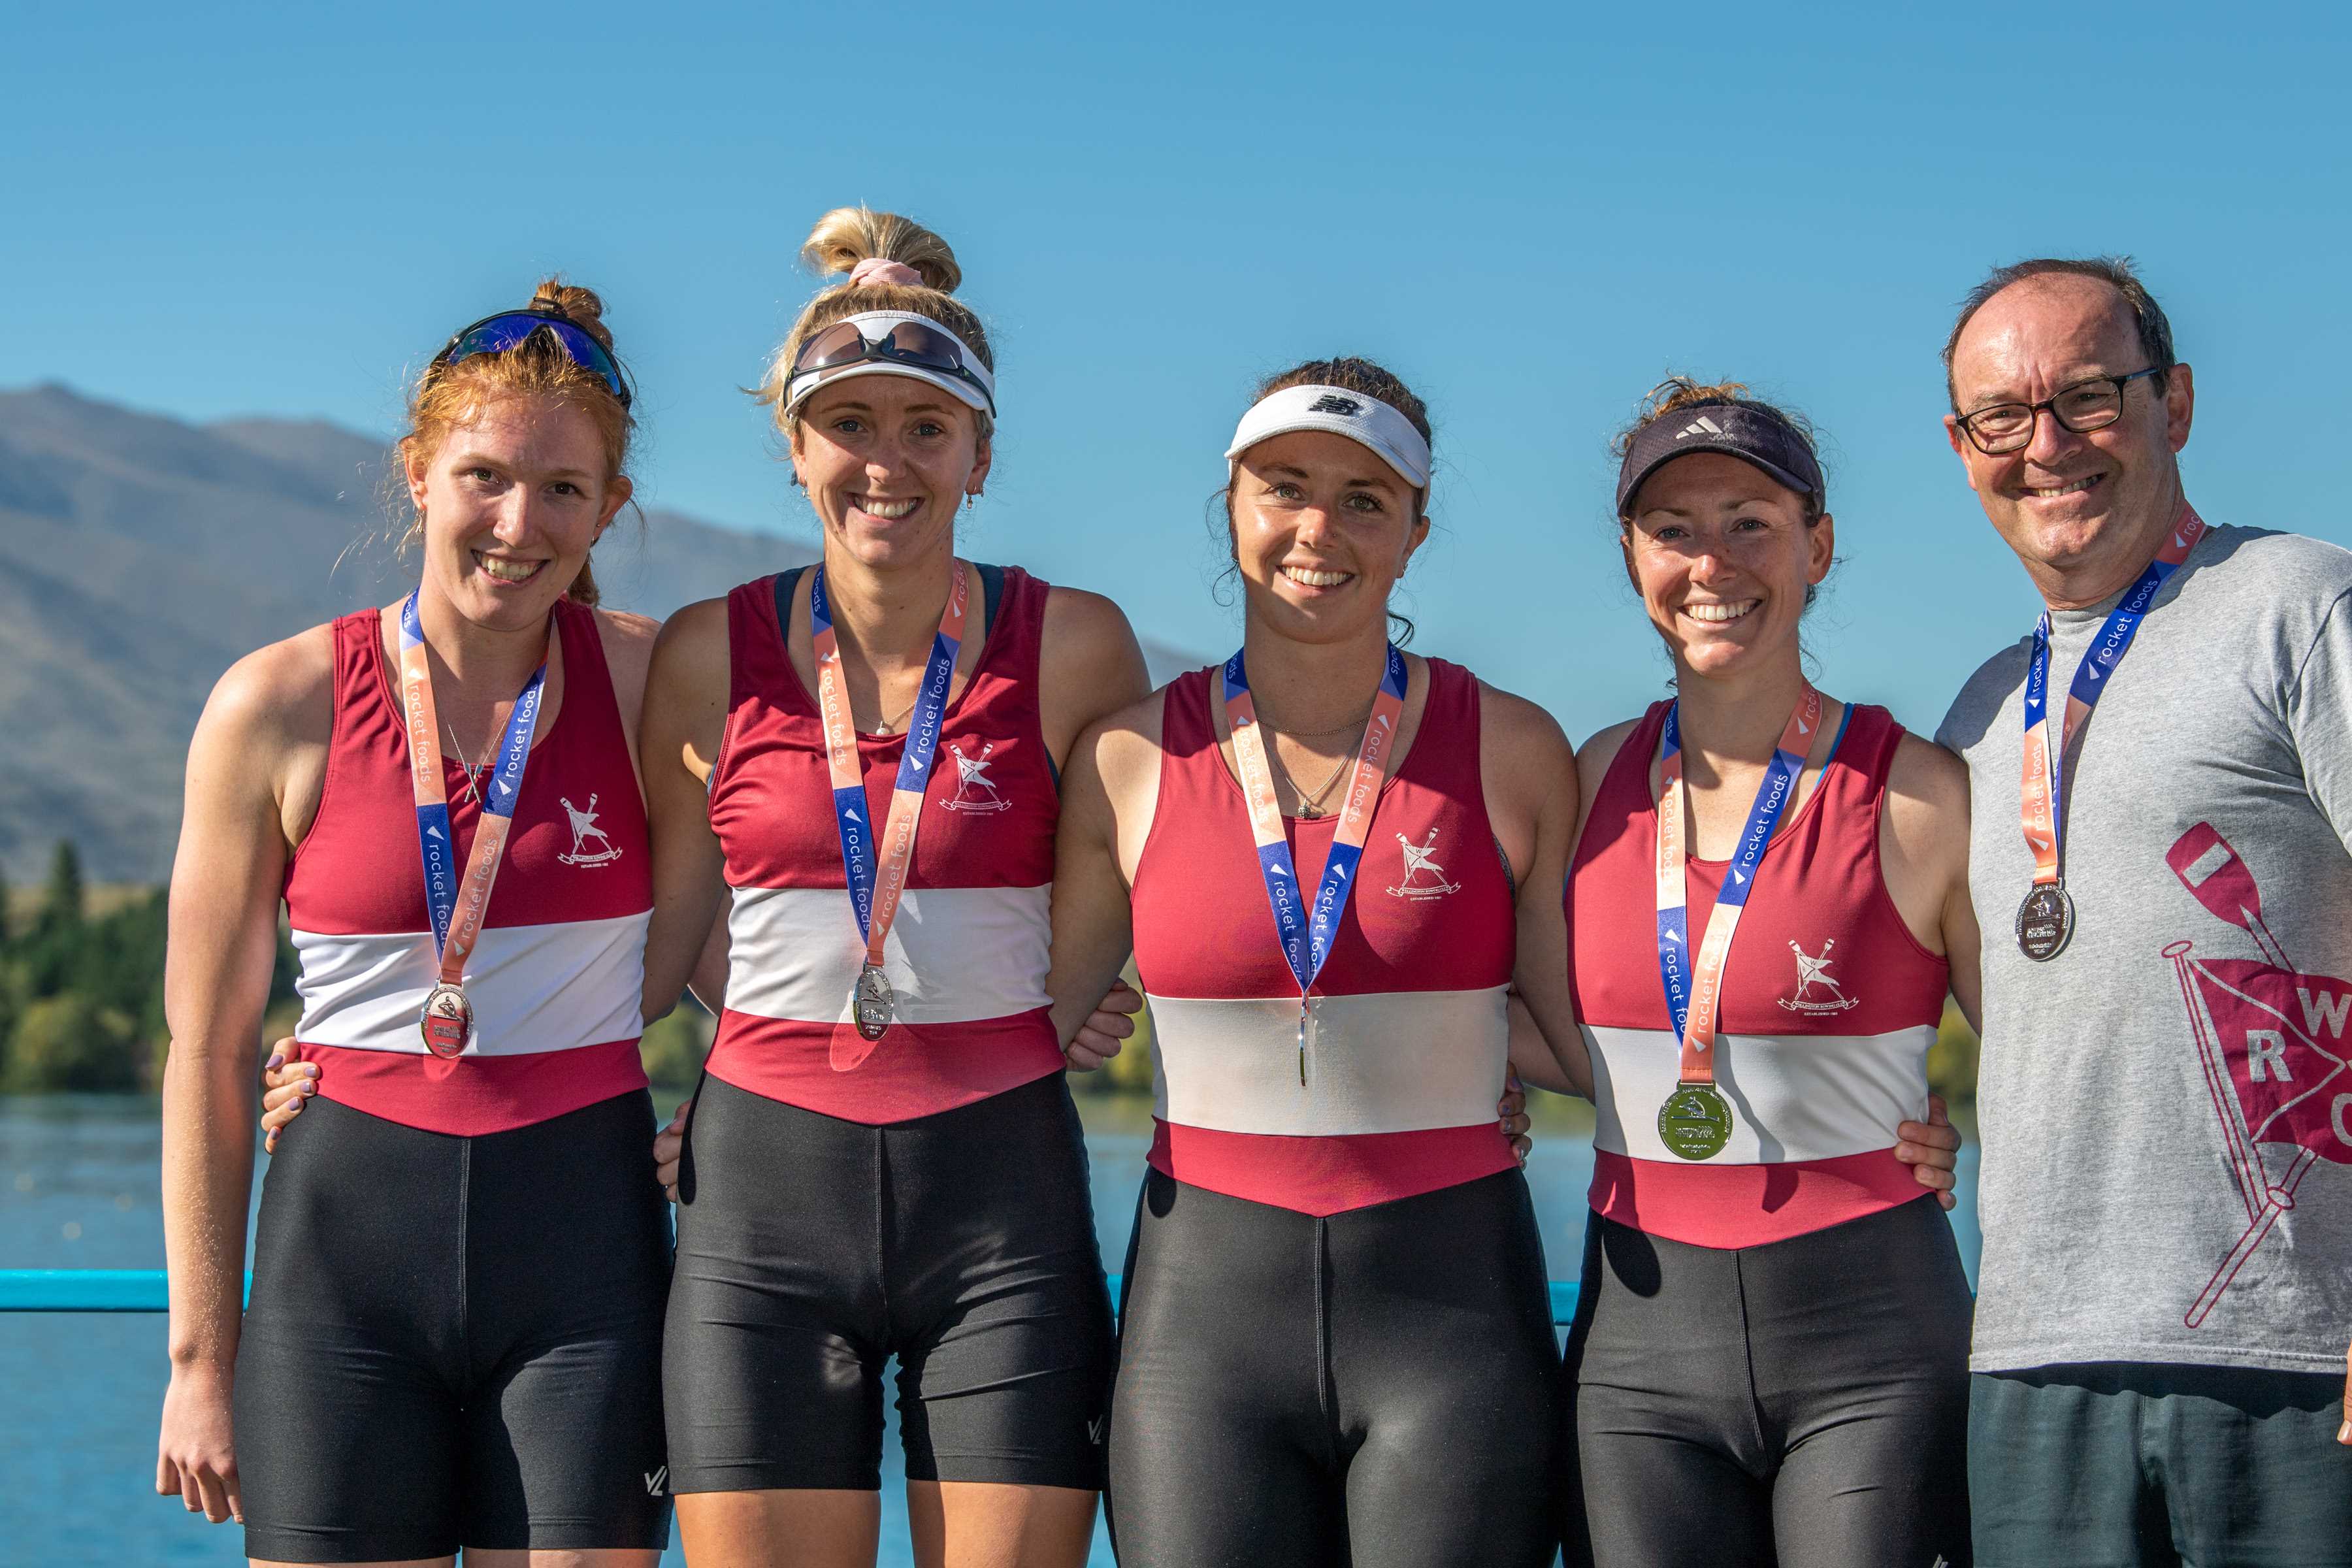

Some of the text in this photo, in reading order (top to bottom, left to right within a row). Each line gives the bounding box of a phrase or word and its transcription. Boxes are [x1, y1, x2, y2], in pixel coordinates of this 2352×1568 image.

[2097, 580, 2159, 665] rocket foods
[408, 685, 433, 783] rocket foods
[821, 668, 846, 766] rocket foods
[917, 659, 951, 754] rocket foods
[505, 729, 527, 777] rocket
[1347, 729, 1383, 824] rocket foods
[2029, 743, 2044, 832] rocket foods
[847, 828, 866, 881] rocket
[1740, 774, 1789, 868] rocket foods
[429, 845, 447, 898] rocket
[460, 838, 498, 939] rocket foods
[882, 815, 911, 917] rocket foods
[1274, 881, 1297, 932] rocket
[1315, 880, 1339, 931] rocket
[1666, 947, 1684, 1002] rocket
[1698, 978, 1714, 1034] rocket
[2296, 987, 2352, 1039] W
[2246, 1030, 2294, 1082] R
